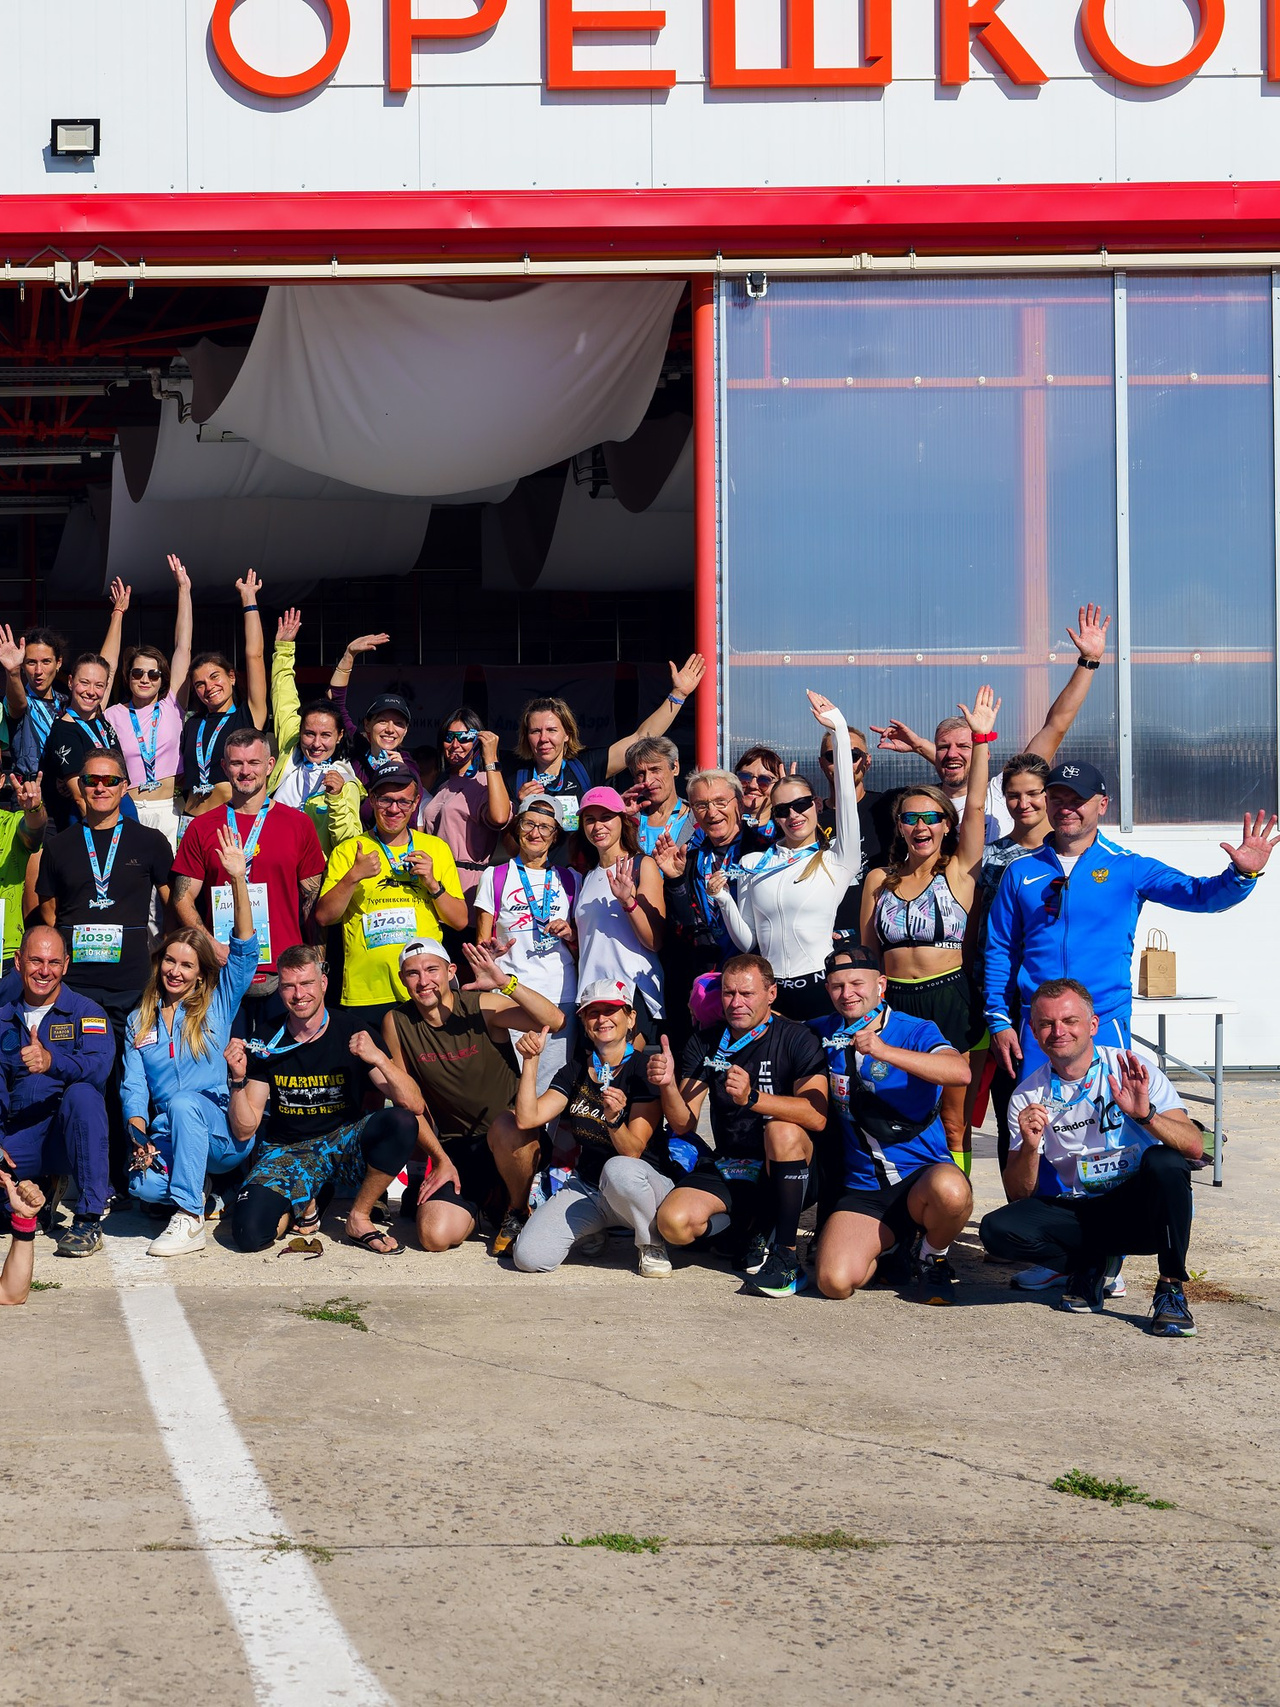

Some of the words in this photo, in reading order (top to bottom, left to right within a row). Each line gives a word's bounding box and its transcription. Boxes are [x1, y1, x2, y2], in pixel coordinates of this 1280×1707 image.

[211, 0, 1280, 98] ОРЕШКО
[373, 916, 406, 928] 1740
[81, 933, 113, 943] 1039
[274, 1074, 345, 1089] WARNING
[1053, 1118, 1096, 1134] Pandora
[1093, 1159, 1130, 1175] 1719
